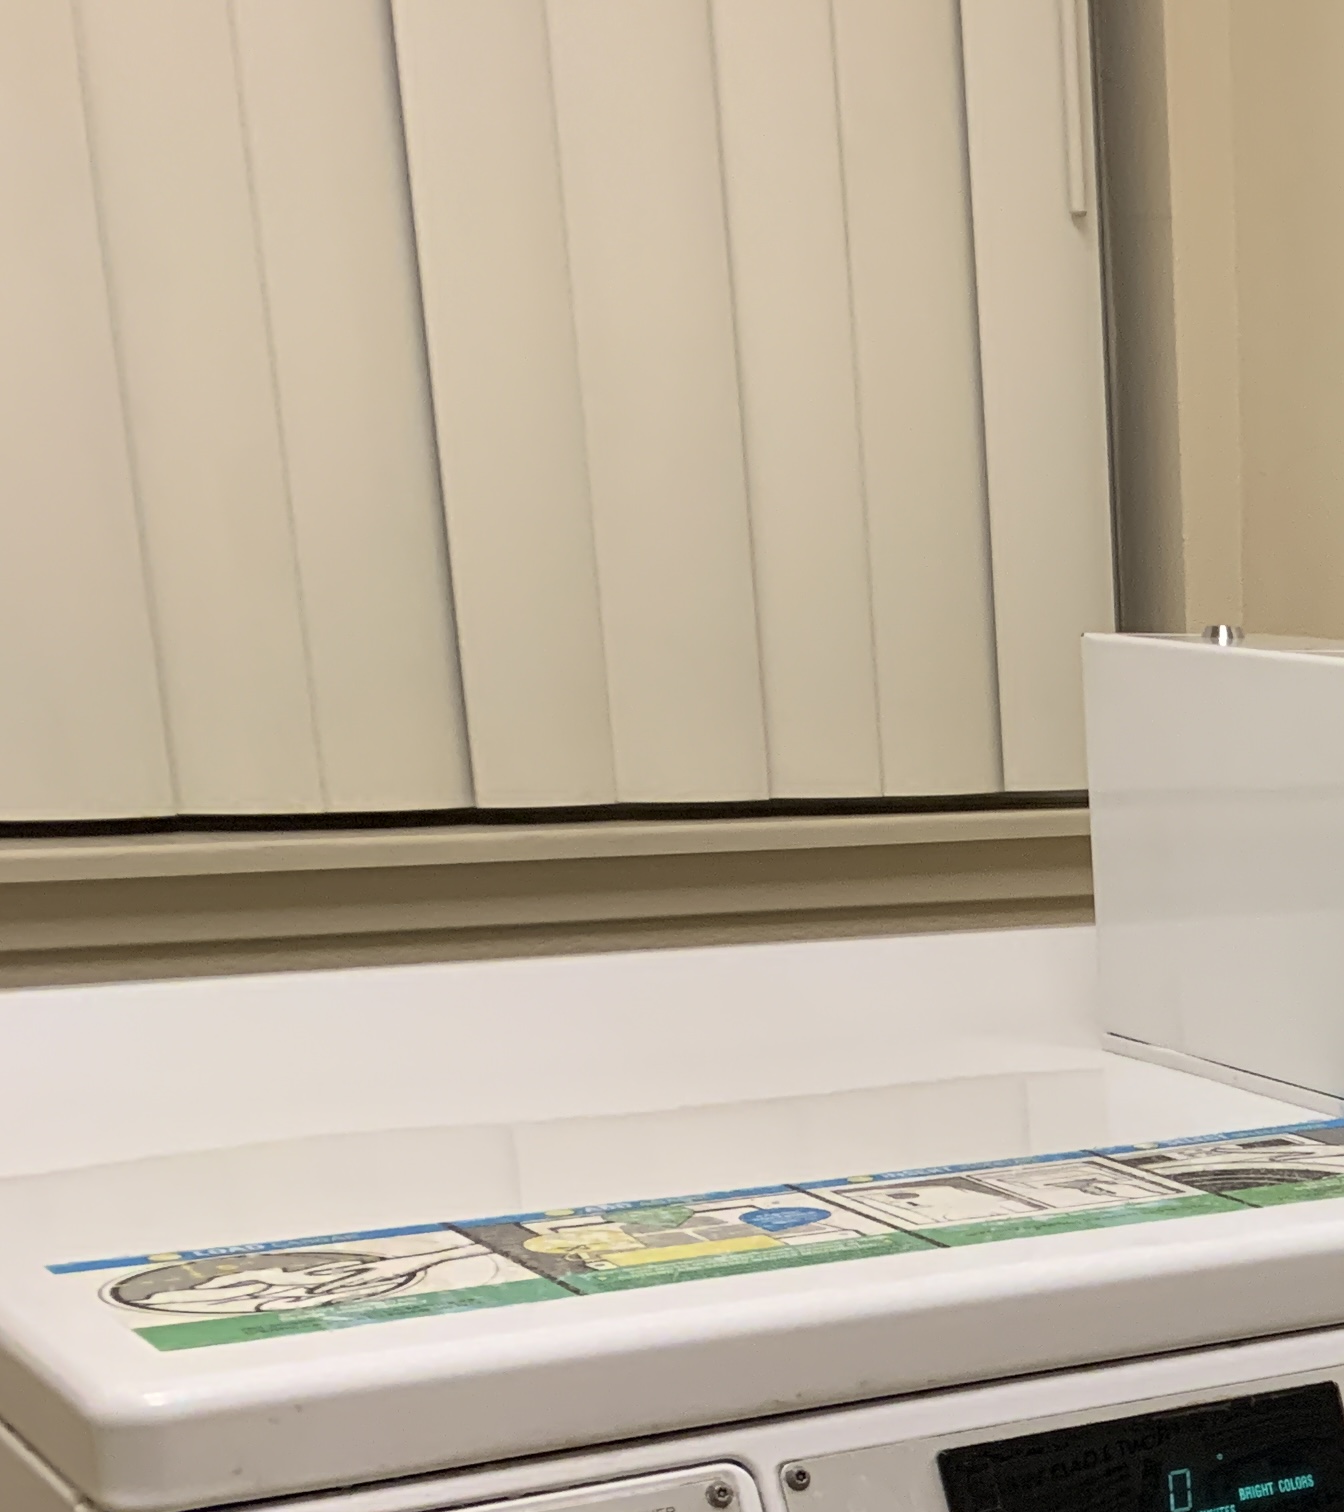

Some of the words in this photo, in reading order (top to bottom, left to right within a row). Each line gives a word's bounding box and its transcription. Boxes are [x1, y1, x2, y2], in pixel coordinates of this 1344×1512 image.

[192, 1243, 265, 1257] LOAD
[1238, 1481, 1274, 1501] BRIGHT
[1278, 1474, 1314, 1492] COLORS
